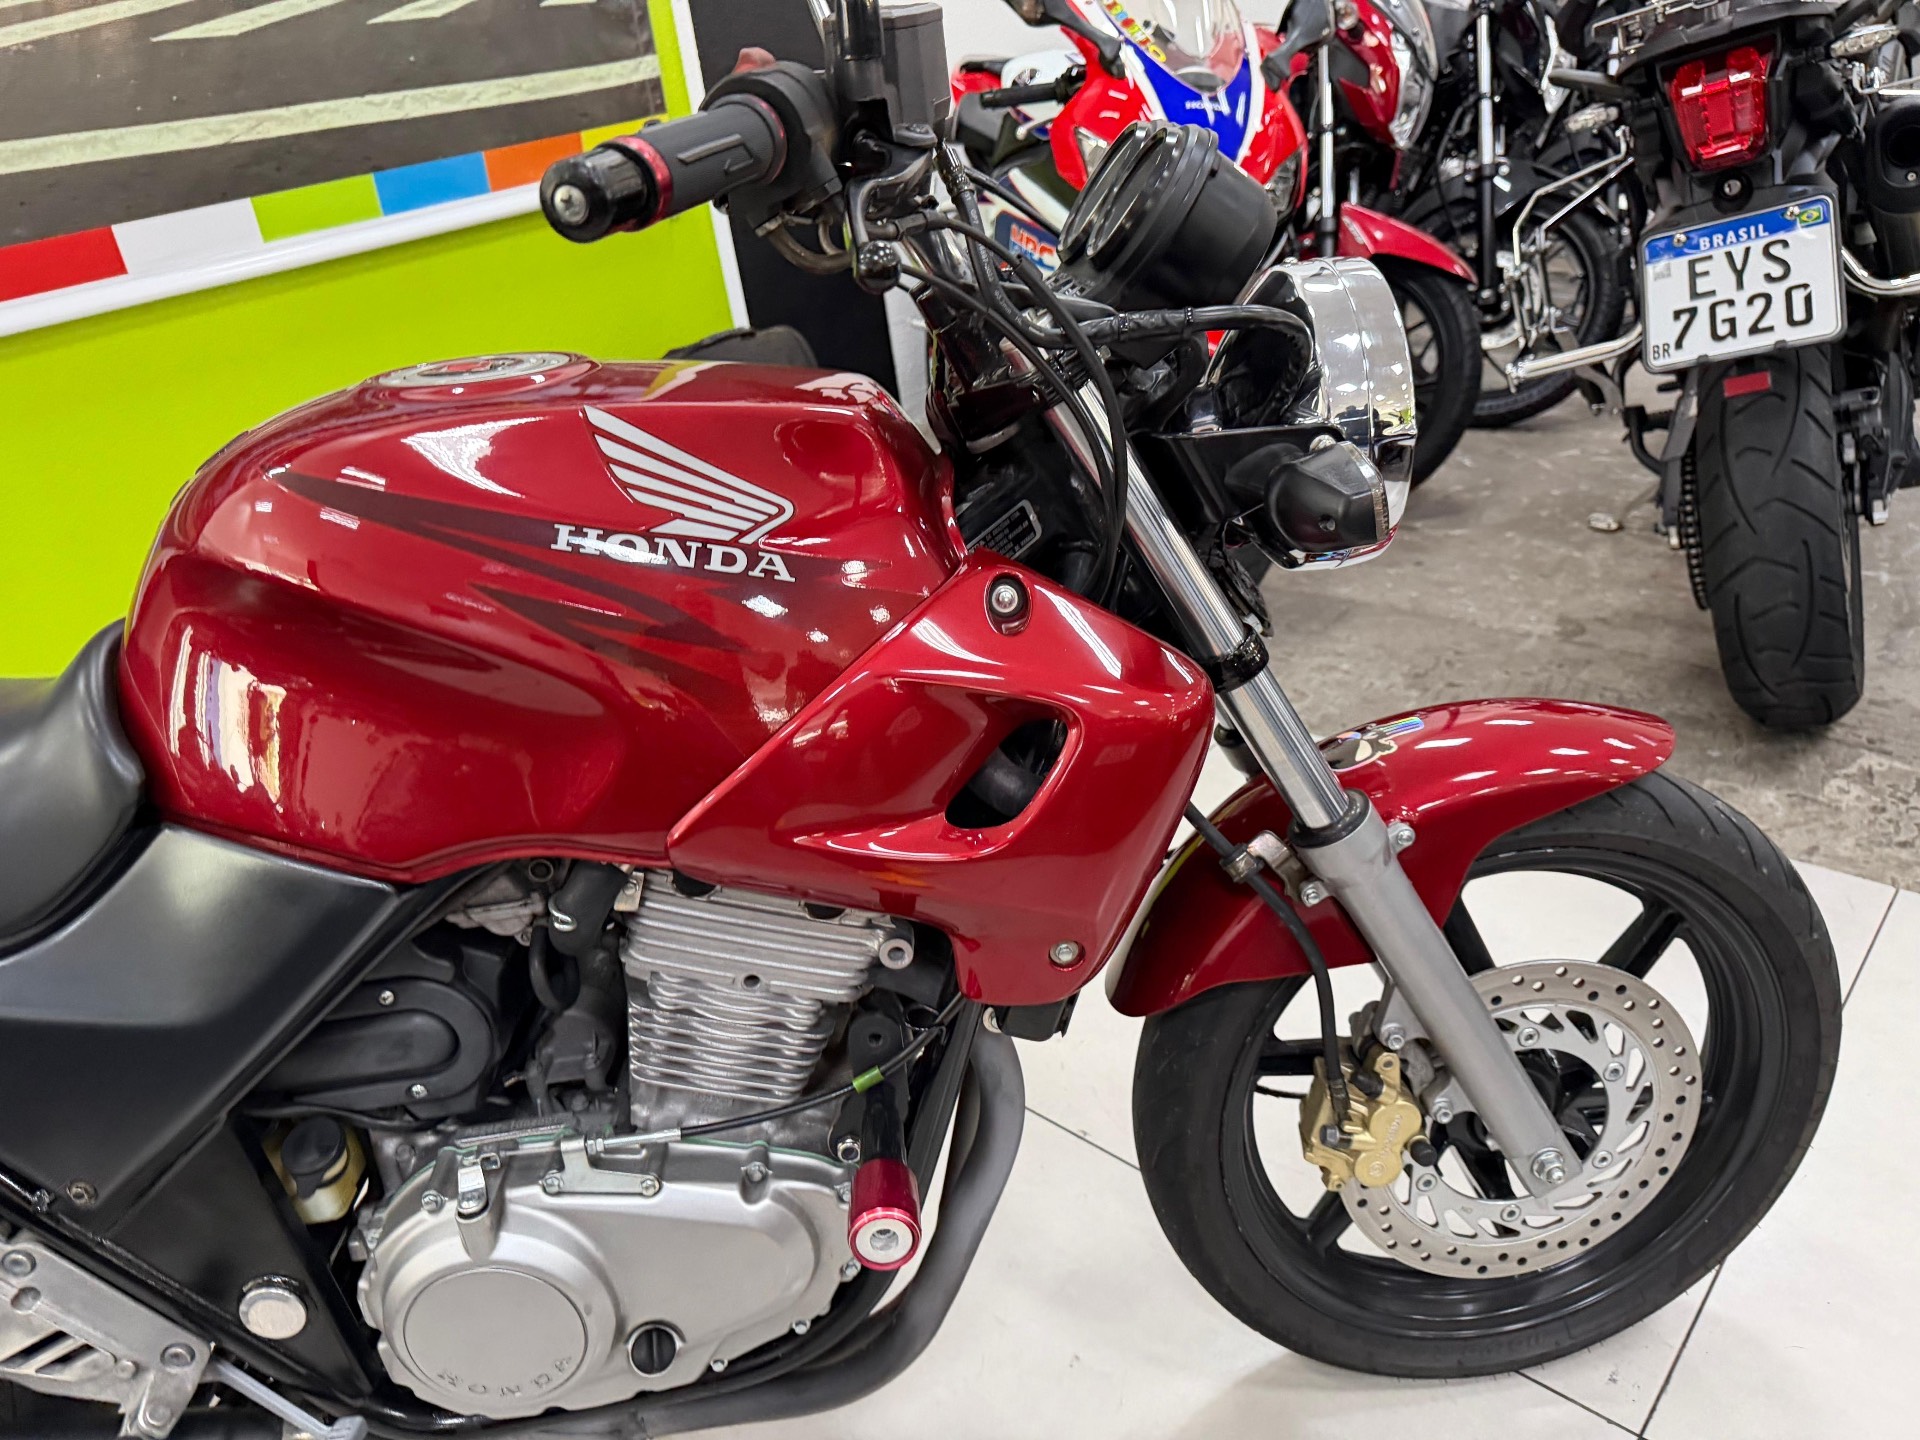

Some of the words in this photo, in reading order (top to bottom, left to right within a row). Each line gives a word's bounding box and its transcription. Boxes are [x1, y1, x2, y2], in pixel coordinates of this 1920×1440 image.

[1698, 223, 1769, 250] BRASIL
[1688, 239, 1791, 300] EYS
[1673, 283, 1813, 350] 7G20
[1652, 342, 1671, 360] BR
[551, 523, 796, 582] HONDA
